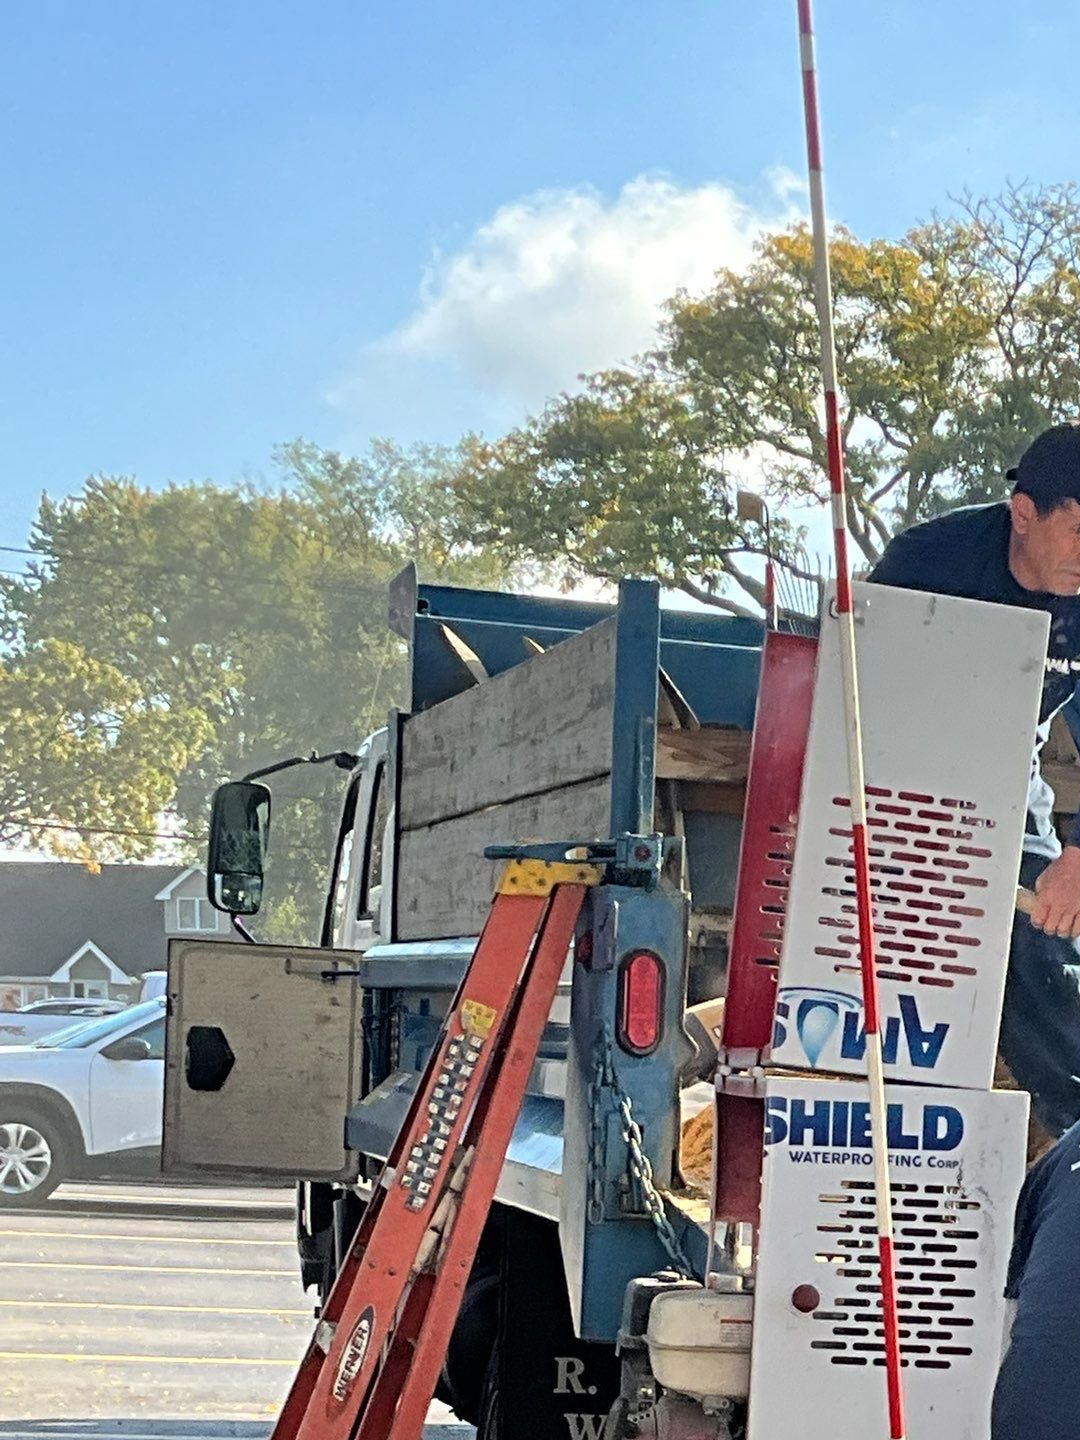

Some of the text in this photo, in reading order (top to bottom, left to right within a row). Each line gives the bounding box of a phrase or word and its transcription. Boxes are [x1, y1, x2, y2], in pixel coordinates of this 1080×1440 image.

[765, 1096, 964, 1151] SHIELD
[789, 1150, 922, 1168] WATERPROFING
[553, 1356, 598, 1395] R.
